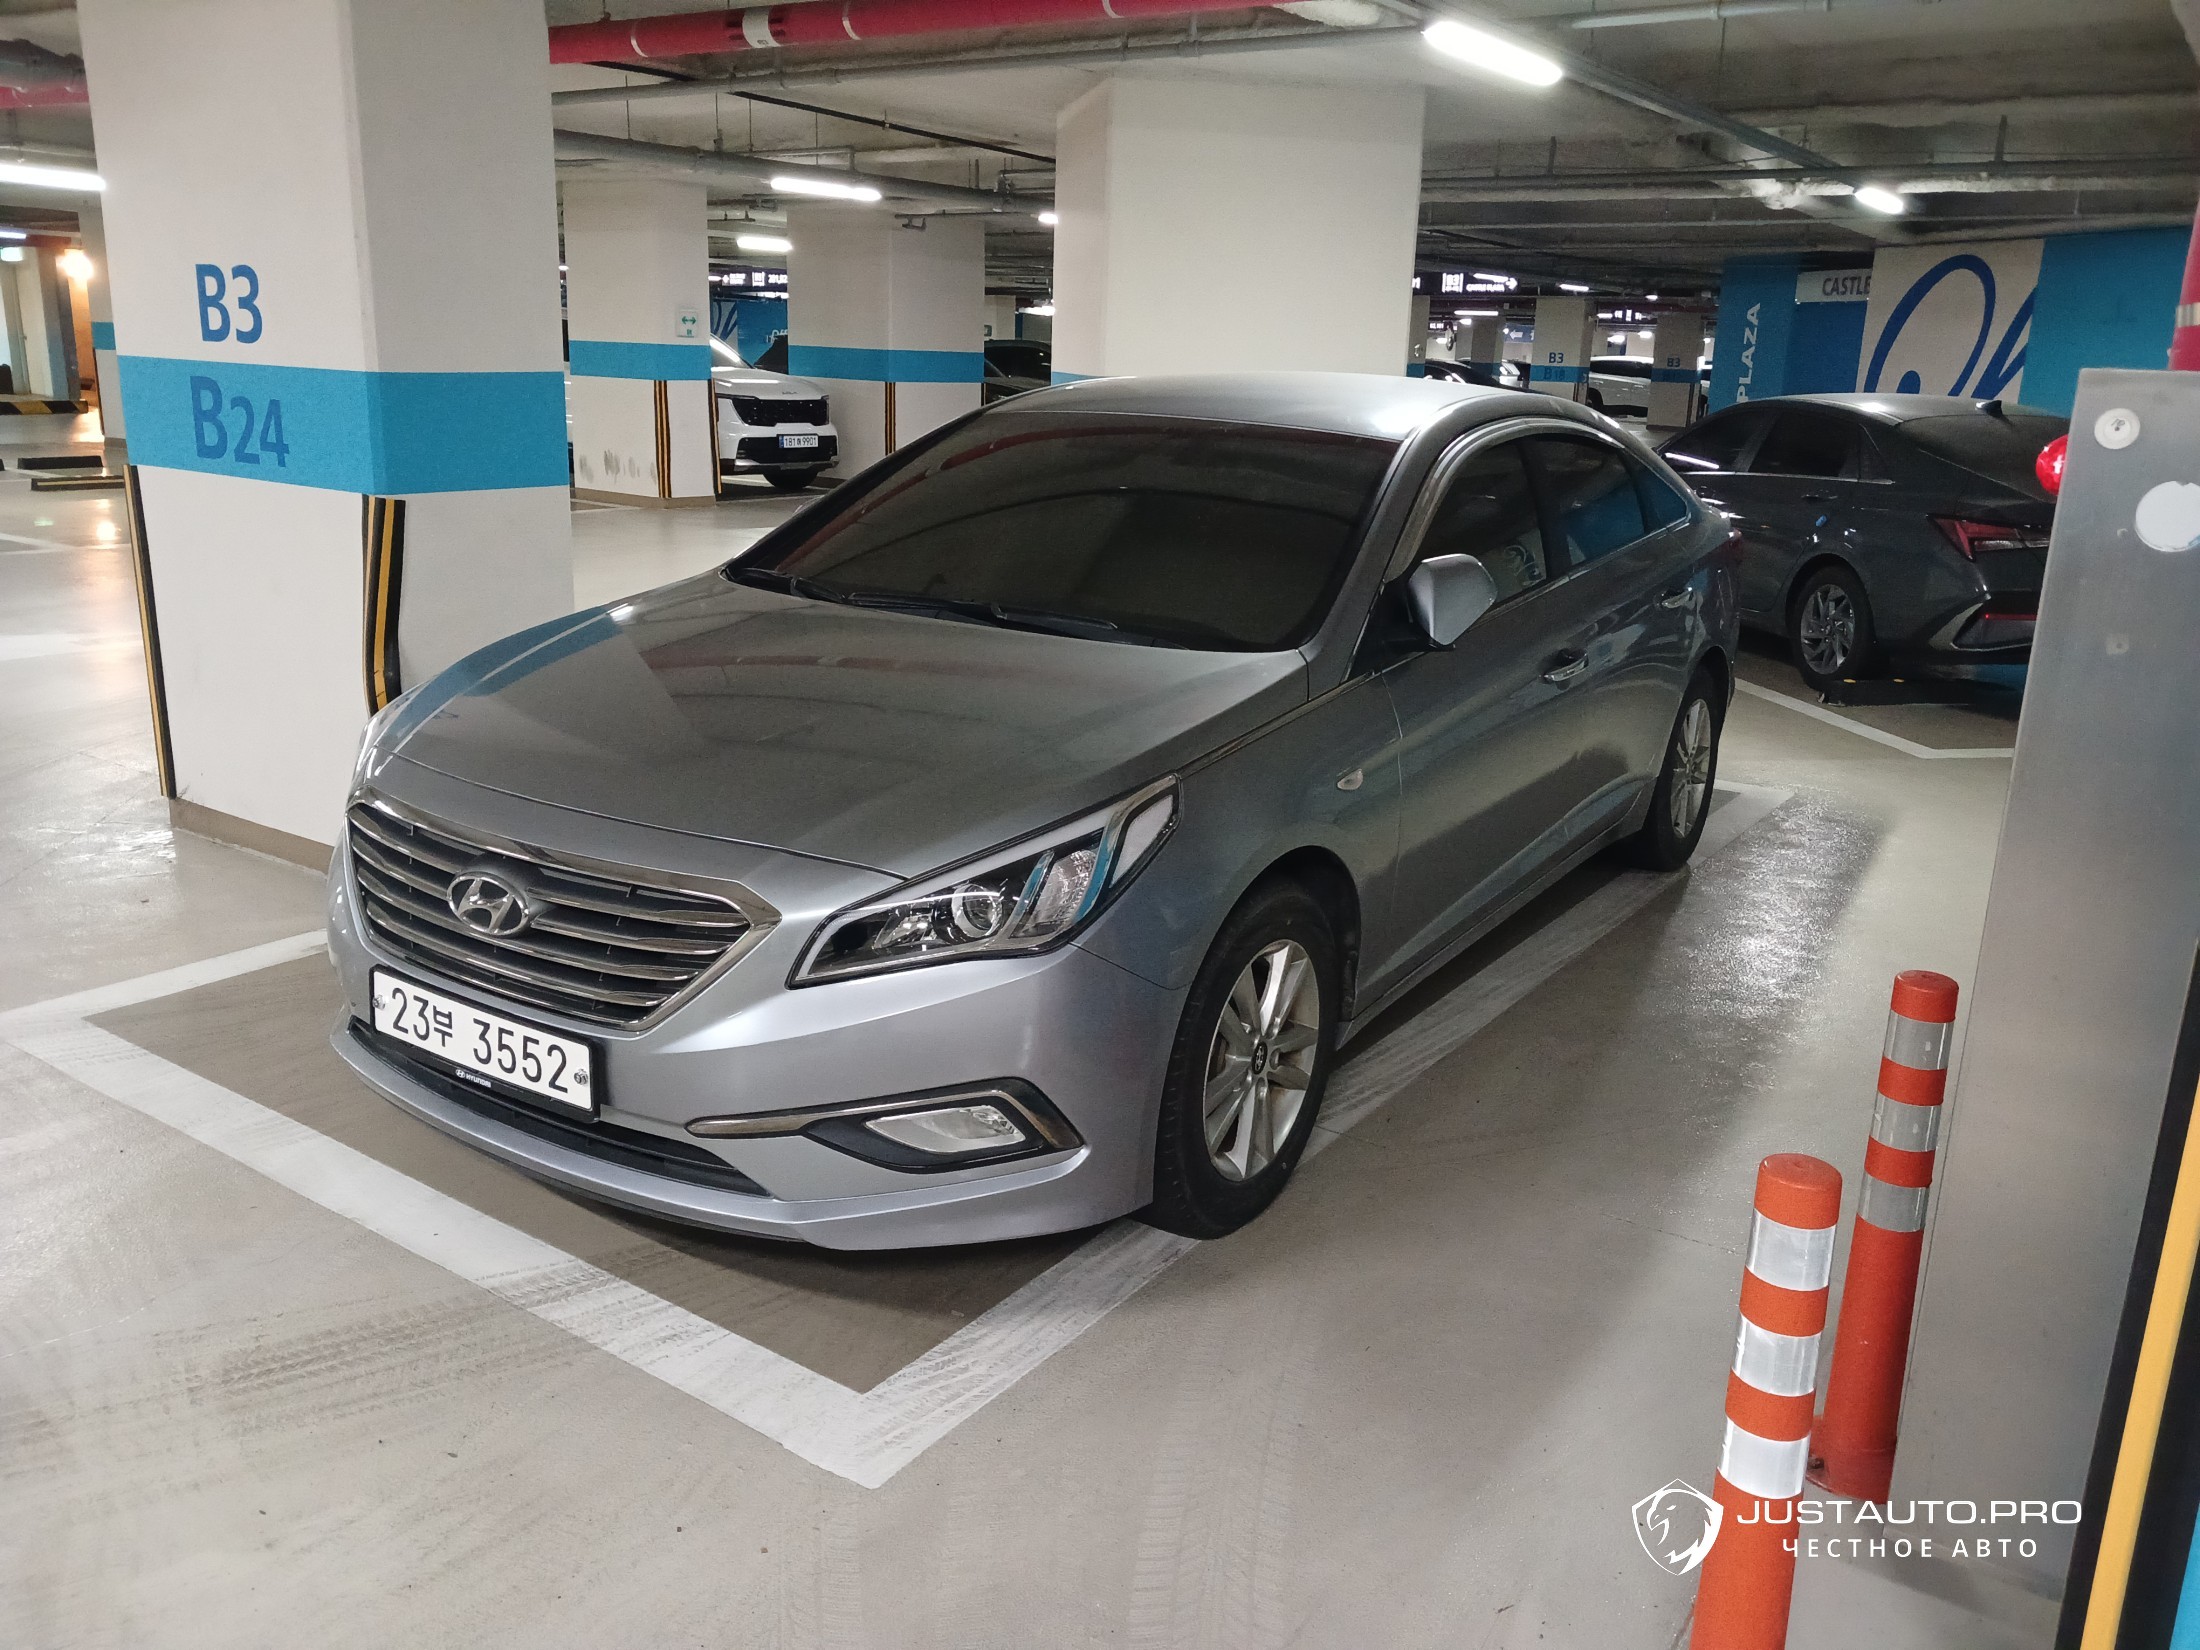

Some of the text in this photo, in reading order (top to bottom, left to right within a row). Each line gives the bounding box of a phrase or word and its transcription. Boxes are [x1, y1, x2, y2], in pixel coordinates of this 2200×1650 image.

[195, 263, 263, 344] B3
[1548, 351, 1564, 364] B3
[1667, 357, 1681, 368] B3
[1736, 303, 1761, 403] PLAZA
[190, 375, 290, 468] B24
[391, 987, 569, 1094] 23부 3552
[465, 1072, 492, 1089] HYUNDAI
